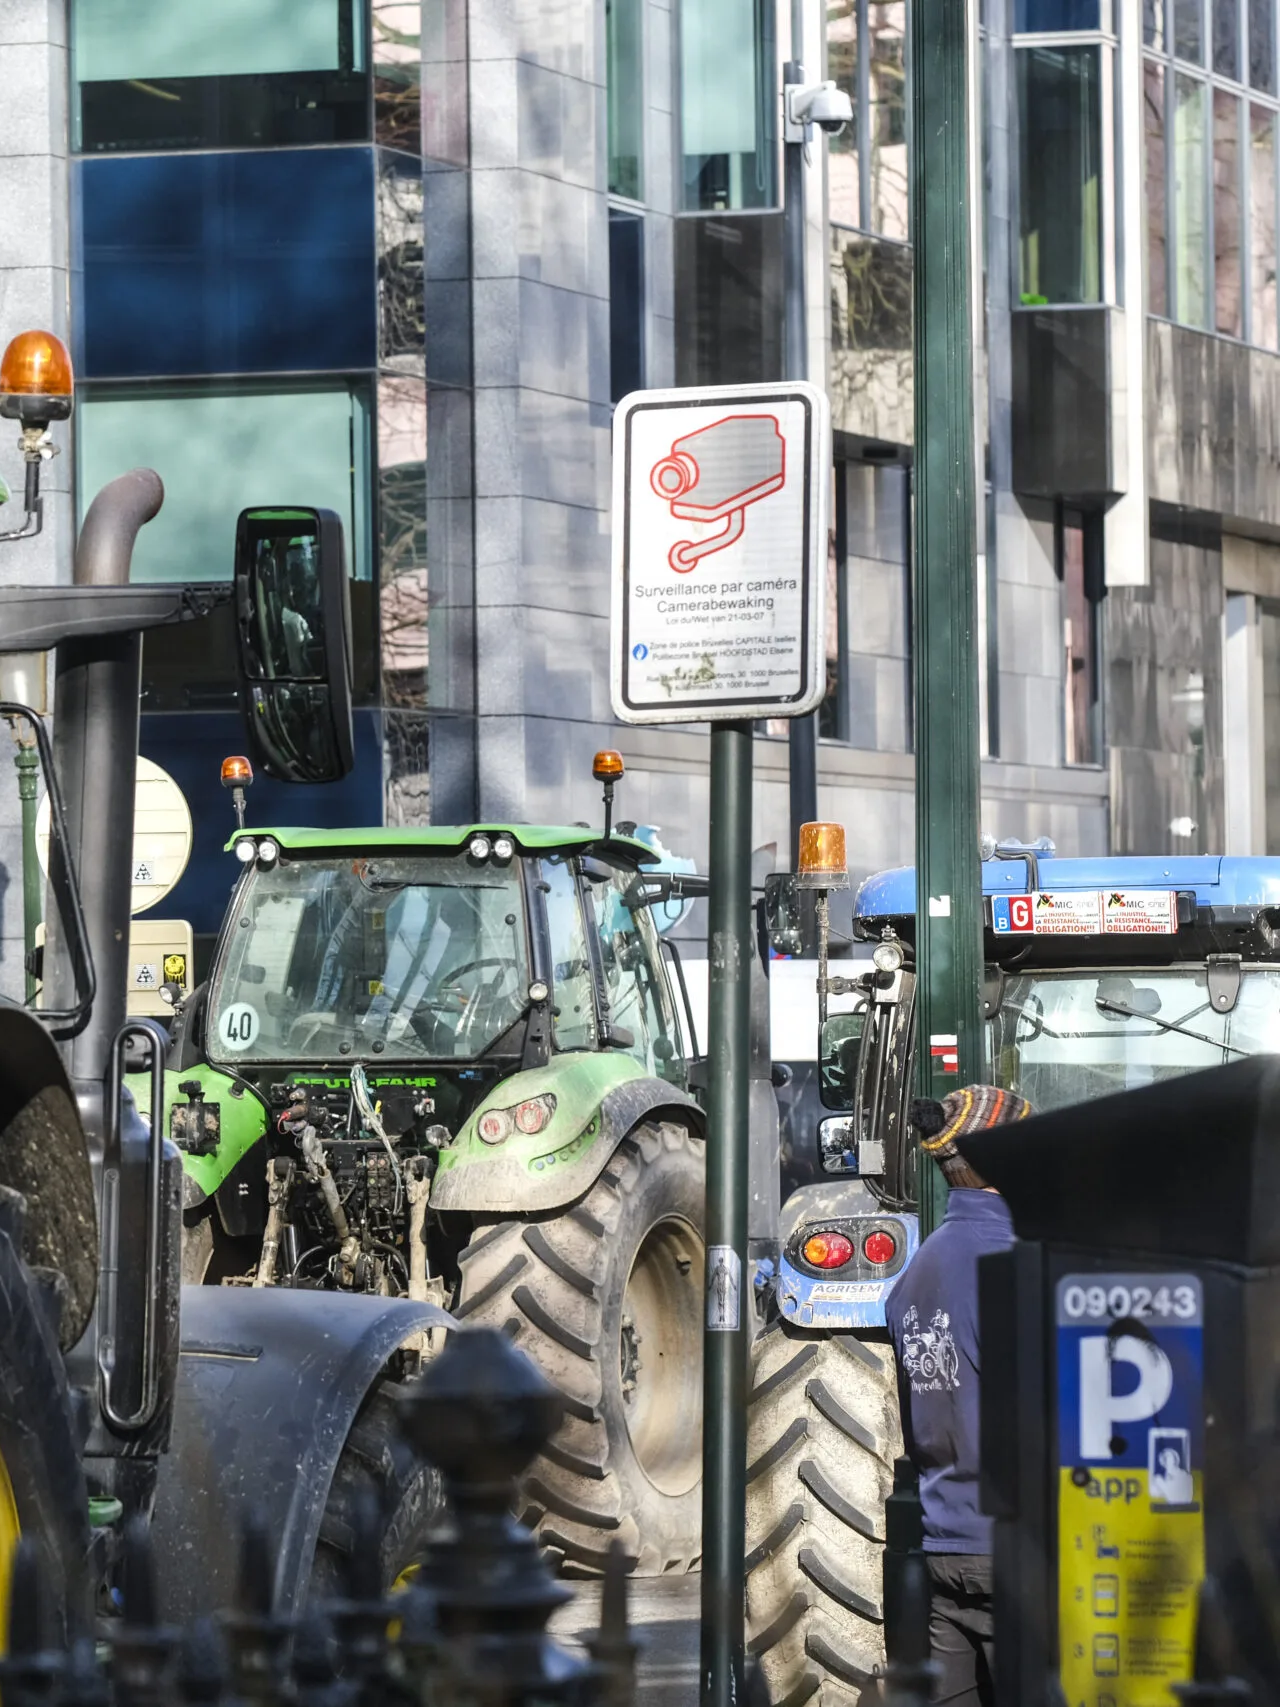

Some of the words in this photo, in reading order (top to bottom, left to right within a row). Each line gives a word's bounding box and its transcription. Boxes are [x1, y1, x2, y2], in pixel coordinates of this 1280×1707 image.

[634, 583, 717, 598] Surveillance
[721, 582, 742, 596] par
[747, 578, 797, 592] caméra
[657, 596, 774, 613] Camerabewaking
[727, 612, 764, 622] 21-03-07
[650, 641, 667, 650] Zone
[680, 640, 700, 649] police
[701, 639, 734, 648] Bruxelles
[735, 636, 771, 646] CAPITALE
[719, 647, 768, 657] HOOFDSTAD
[750, 670, 766, 678] 1000
[726, 681, 742, 689] 1000
[998, 917, 1008, 929] B
[1012, 900, 1029, 927] G
[1035, 924, 1095, 933] OBLIGATION!!!
[1106, 924, 1166, 932] OBLIGATION!!!
[227, 1012, 252, 1041] 40
[294, 1077, 436, 1088] DEUT-FAHR
[814, 1284, 882, 1293] AGRISEM
[1064, 1286, 1197, 1318] 090243
[1079, 1334, 1173, 1459] P
[1084, 1476, 1141, 1504] app
